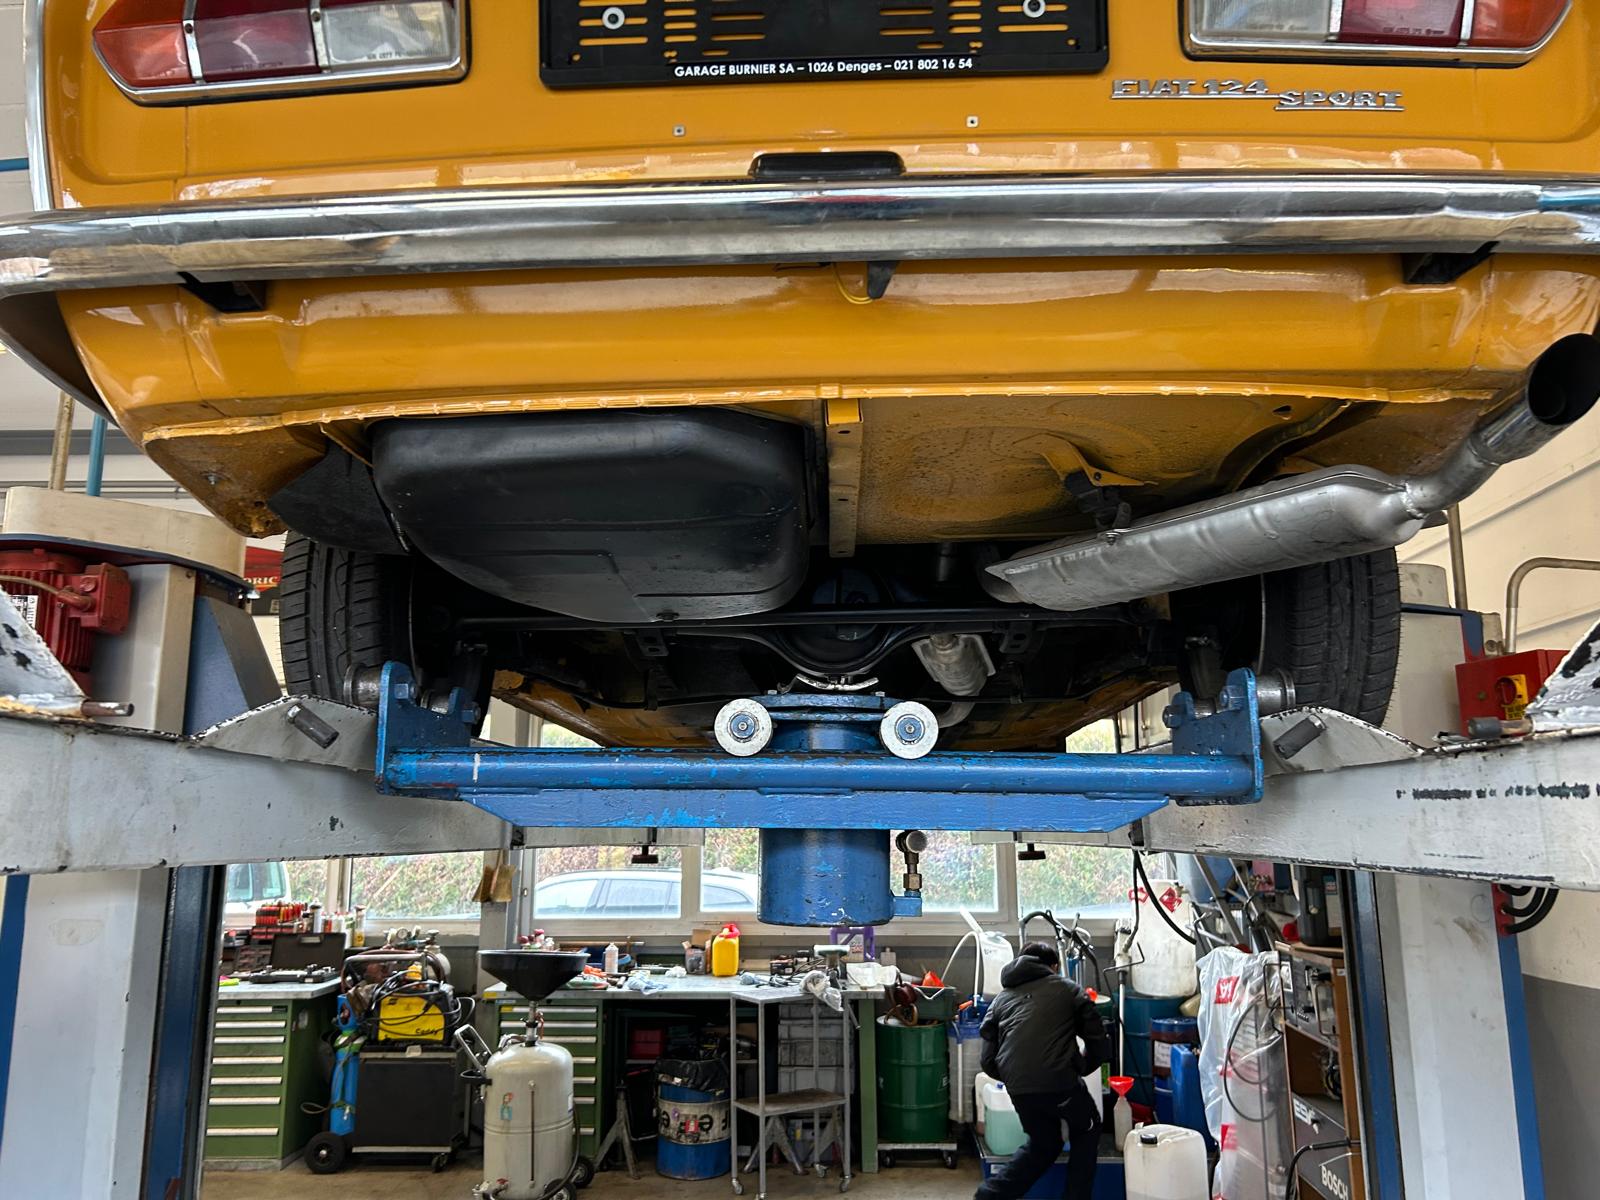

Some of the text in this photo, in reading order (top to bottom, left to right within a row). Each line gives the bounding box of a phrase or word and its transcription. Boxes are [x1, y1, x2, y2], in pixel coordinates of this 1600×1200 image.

[674, 64, 726, 77] GARAGE
[728, 63, 776, 75] BURNIER
[779, 62, 795, 74] SA
[807, 62, 834, 73] 1026
[837, 61, 882, 74] Denges
[894, 60, 914, 71] 021
[917, 59, 939, 70] 802
[942, 58, 956, 69] 16
[958, 58, 973, 69] 54
[1112, 78, 1270, 96] FIAT 124
[1279, 90, 1403, 107] SPORT
[1321, 1164, 1349, 1200] BOSCH
